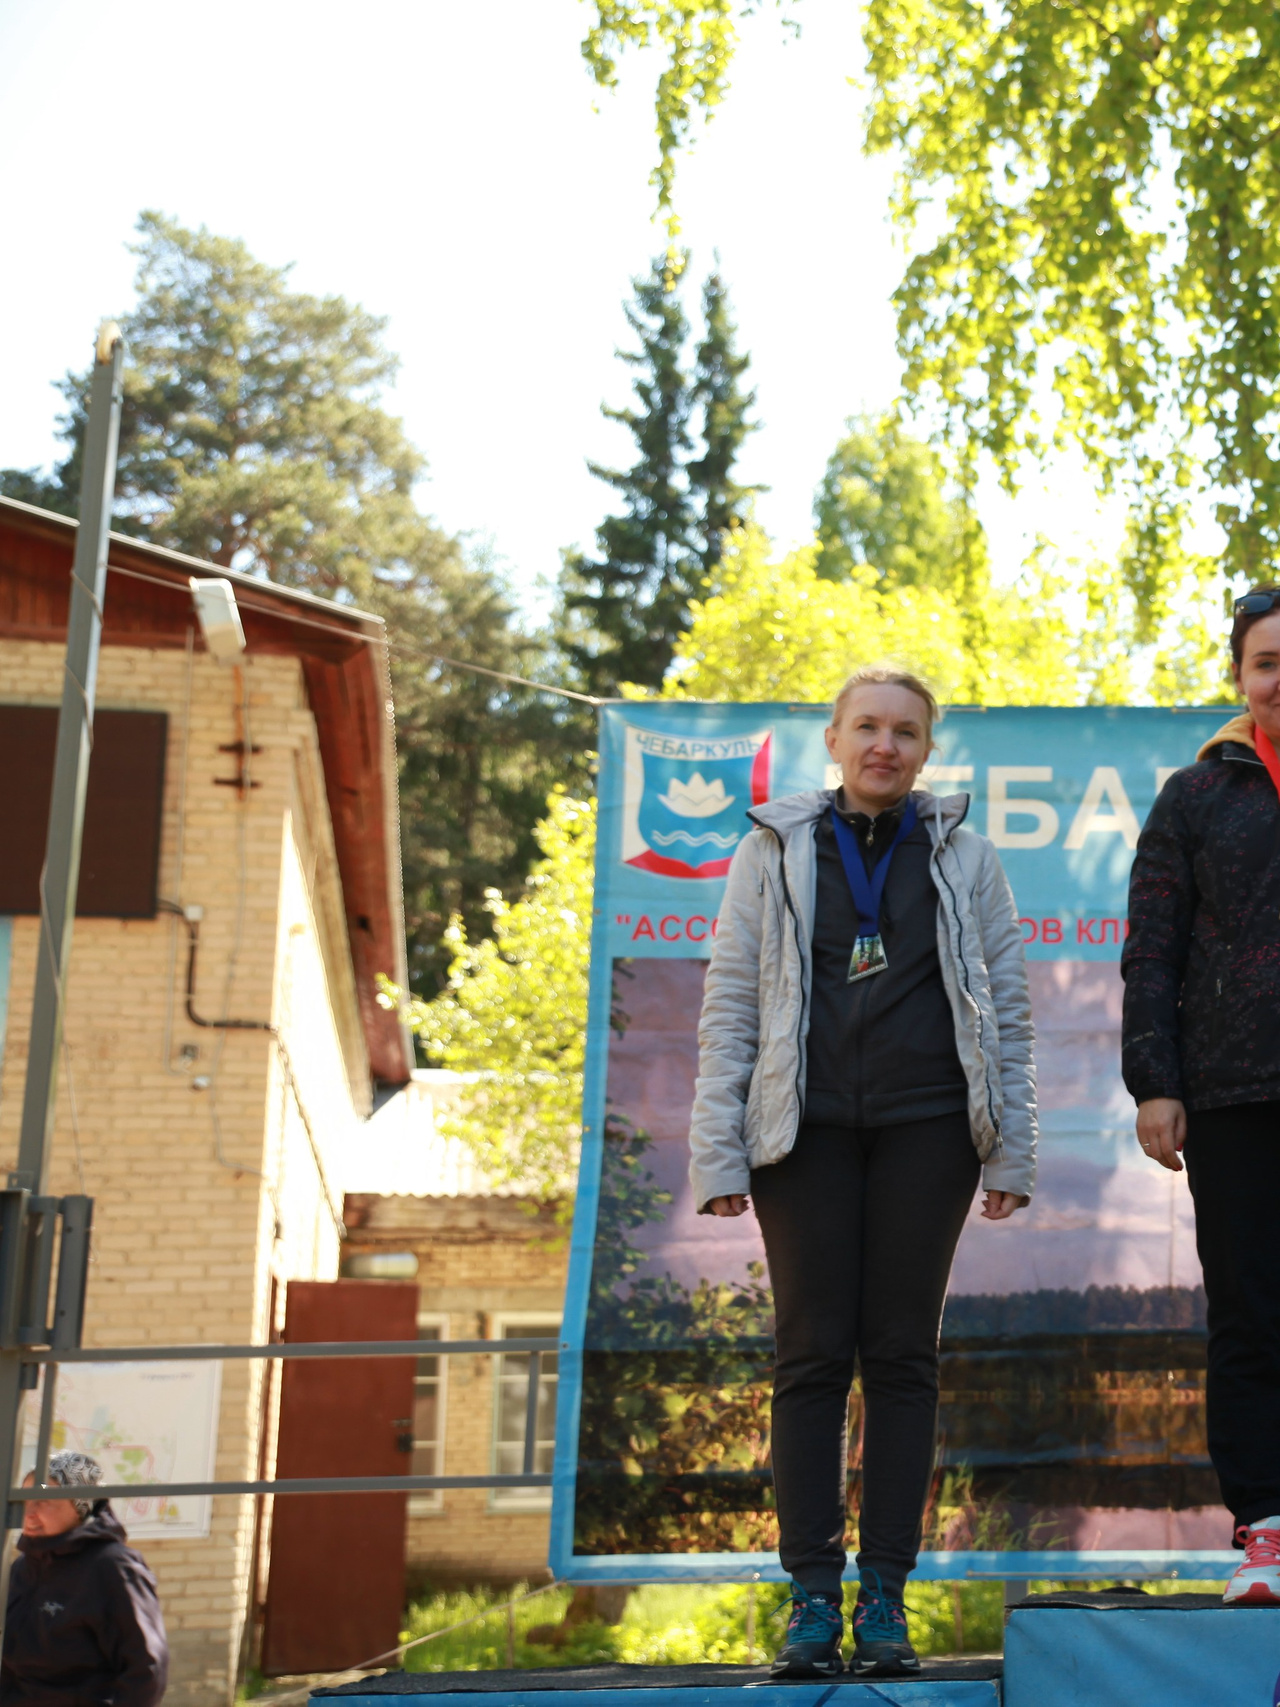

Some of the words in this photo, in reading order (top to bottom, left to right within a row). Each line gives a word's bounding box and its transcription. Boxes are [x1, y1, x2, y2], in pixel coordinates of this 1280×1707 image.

[635, 733, 761, 758] ЧЕБАРКУЛЬ
[615, 914, 719, 942] "АСС
[1076, 917, 1130, 945] КЛ
